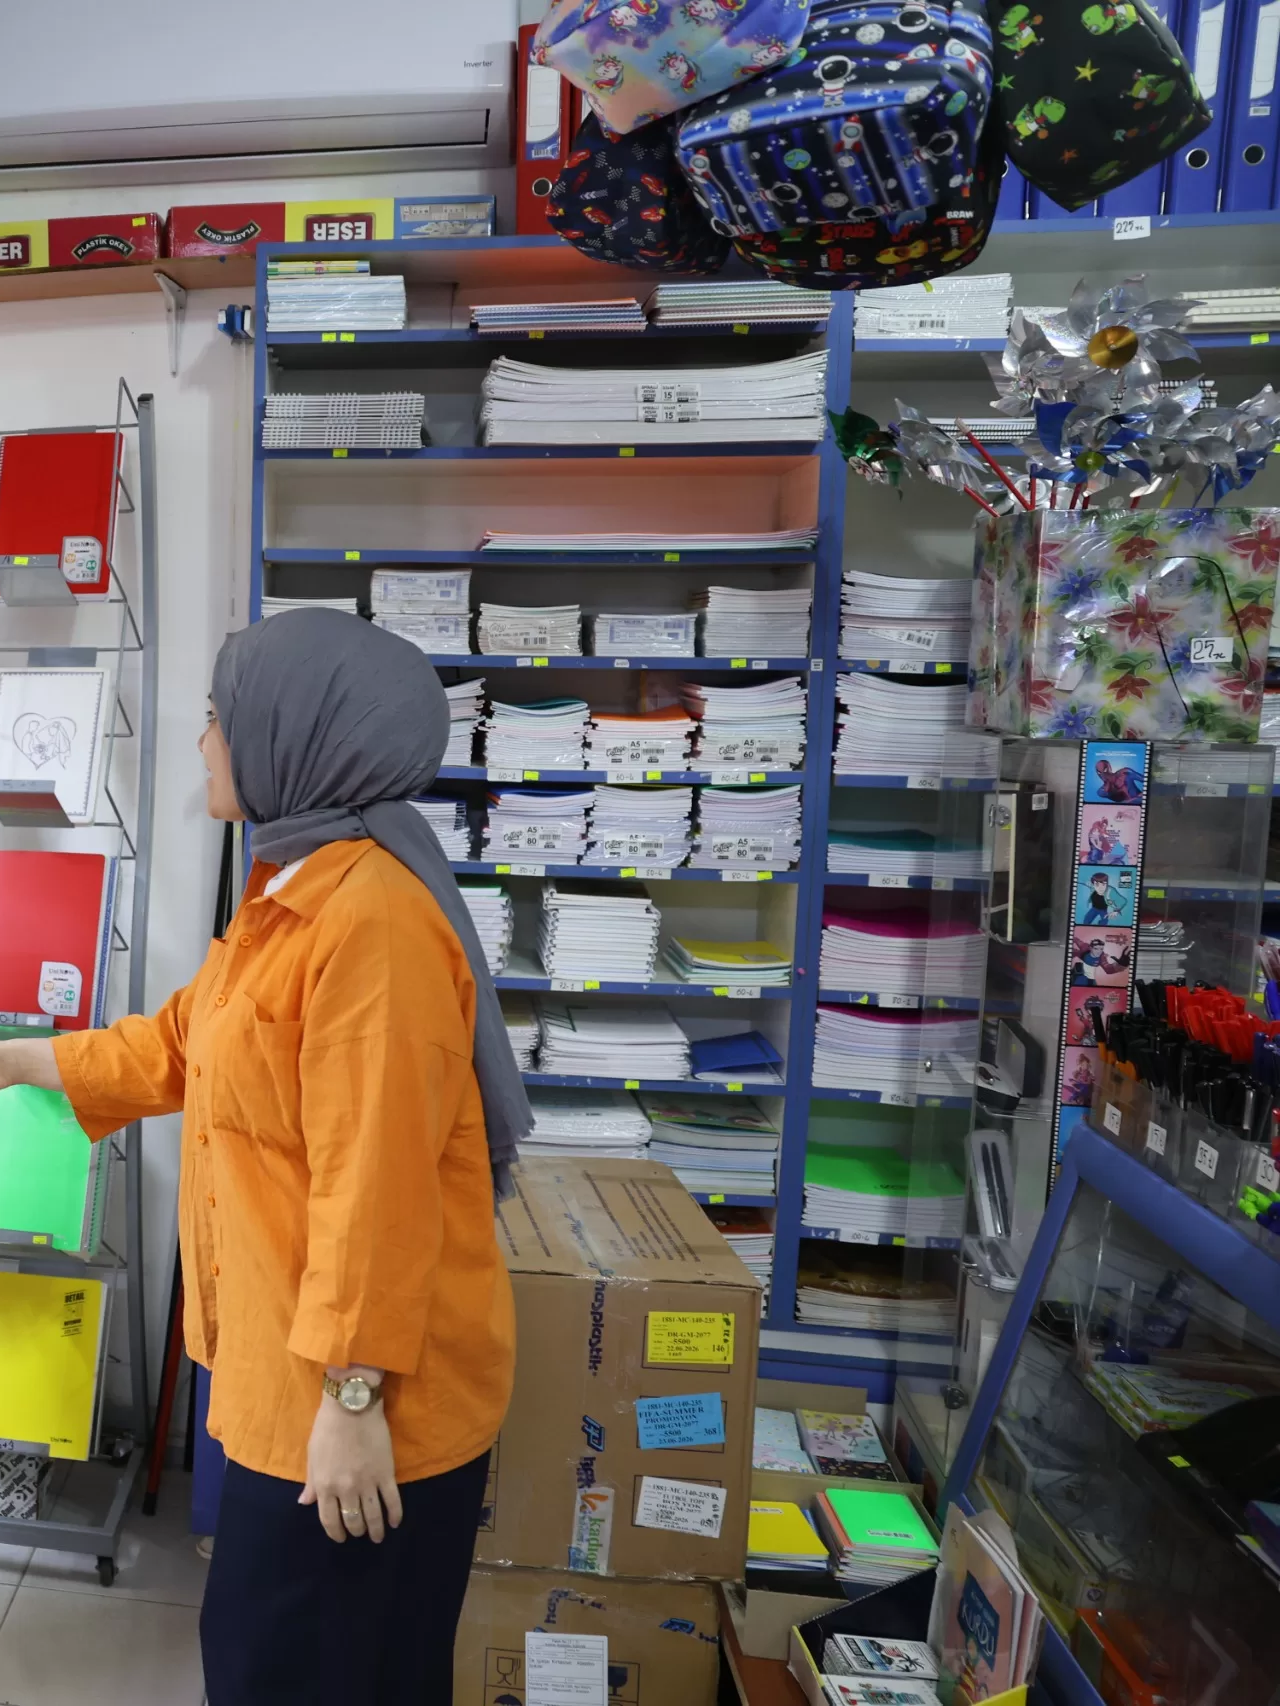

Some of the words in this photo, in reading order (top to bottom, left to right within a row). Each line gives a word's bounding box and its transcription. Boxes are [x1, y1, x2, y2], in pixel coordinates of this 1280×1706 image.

[463, 60, 494, 69] Inverter
[312, 221, 368, 241] ESER
[108, 239, 129, 253] OKEY
[663, 391, 673, 399] 15
[664, 411, 674, 420] 15
[1193, 640, 1215, 660] 25
[630, 740, 641, 748] A5
[743, 739, 755, 747] A5
[630, 752, 641, 760] 60
[743, 751, 754, 759] 60
[527, 826, 538, 834] A5
[526, 837, 537, 845] 80
[738, 838, 749, 846] A5
[628, 845, 639, 853] 80
[737, 849, 748, 857] 80
[64, 1292, 85, 1304] DETAIL
[712, 1344, 726, 1353] 146
[703, 1427, 717, 1436] 368
